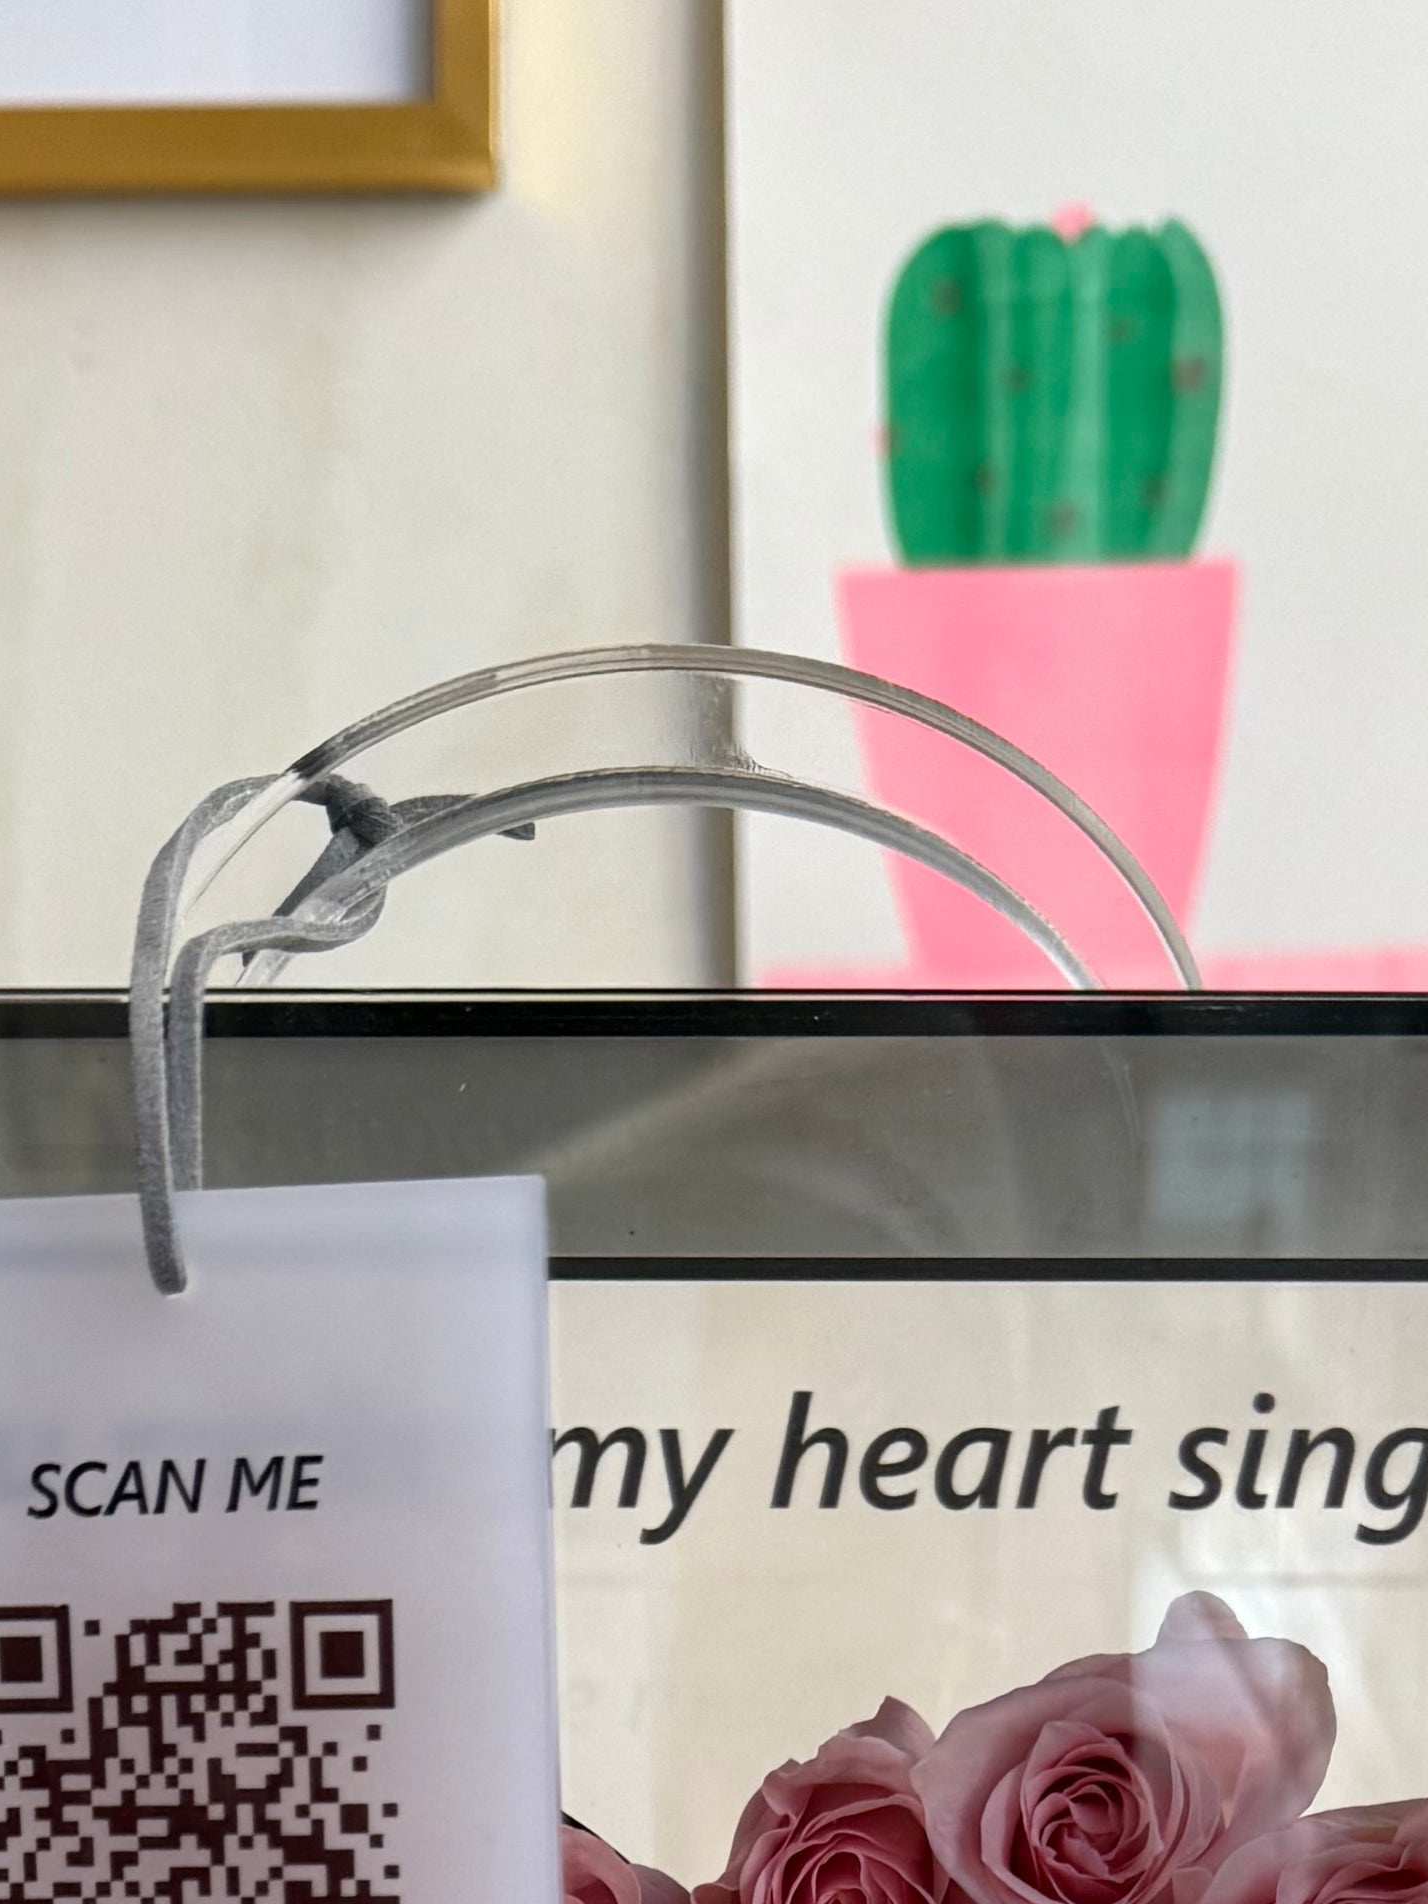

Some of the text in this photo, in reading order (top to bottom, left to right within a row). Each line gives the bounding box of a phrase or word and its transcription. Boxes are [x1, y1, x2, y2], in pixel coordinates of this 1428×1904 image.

[27, 1453, 324, 1518] SCAN ME
[548, 1427, 735, 1545] my
[770, 1390, 1133, 1511] heart
